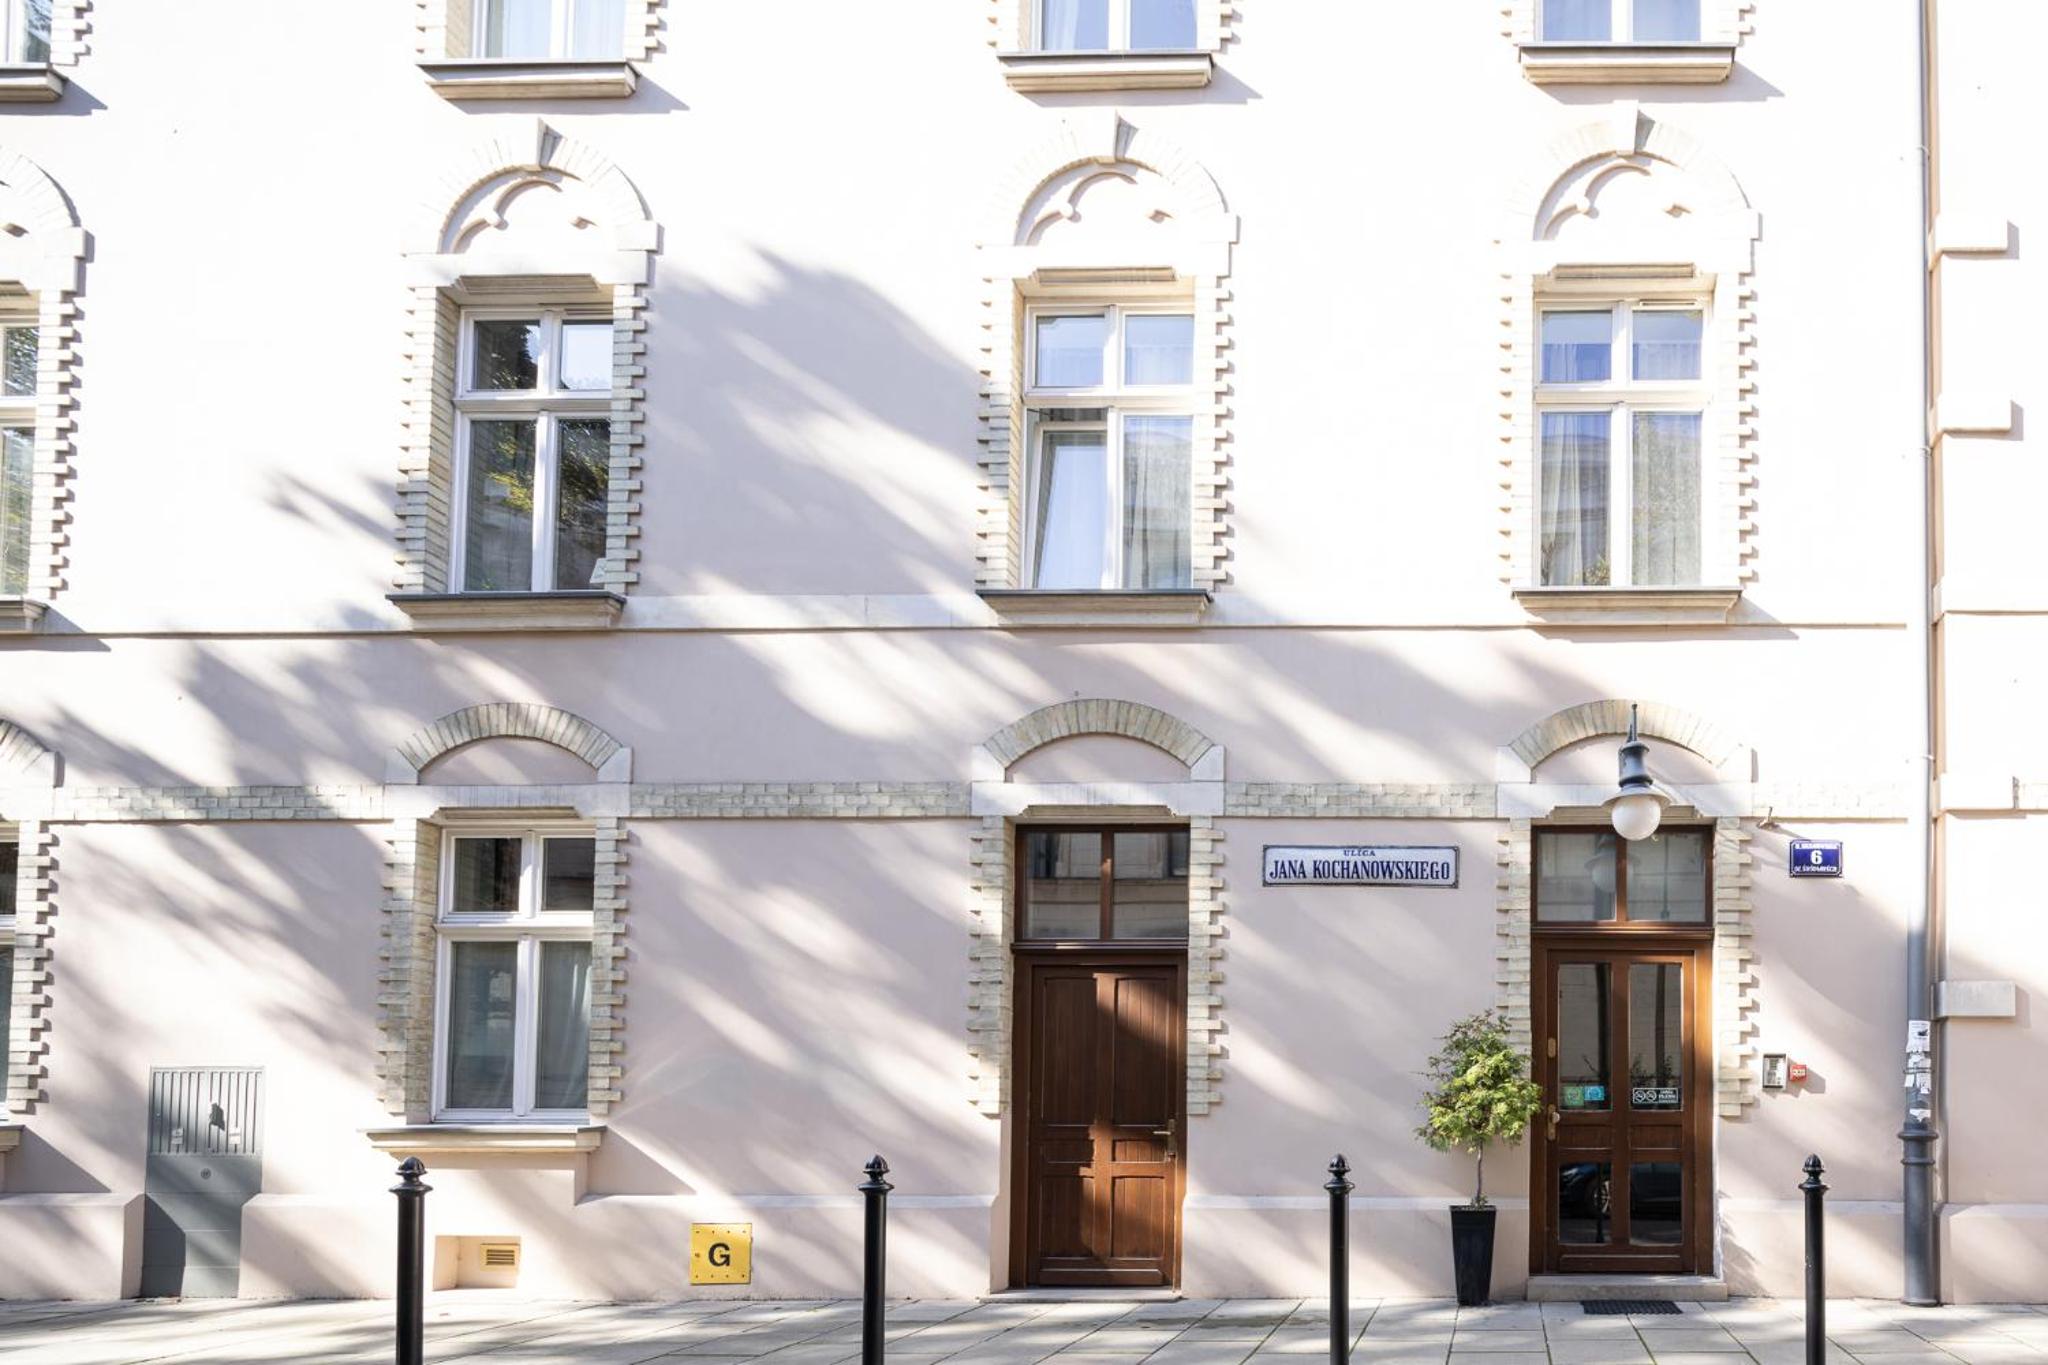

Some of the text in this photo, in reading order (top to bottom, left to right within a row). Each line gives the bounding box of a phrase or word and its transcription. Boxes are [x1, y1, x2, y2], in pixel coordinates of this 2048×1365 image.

[1811, 850, 1823, 864] 6
[1270, 859, 1450, 880] JANA KOCHANOWSKIEGO
[709, 1243, 730, 1267] G
